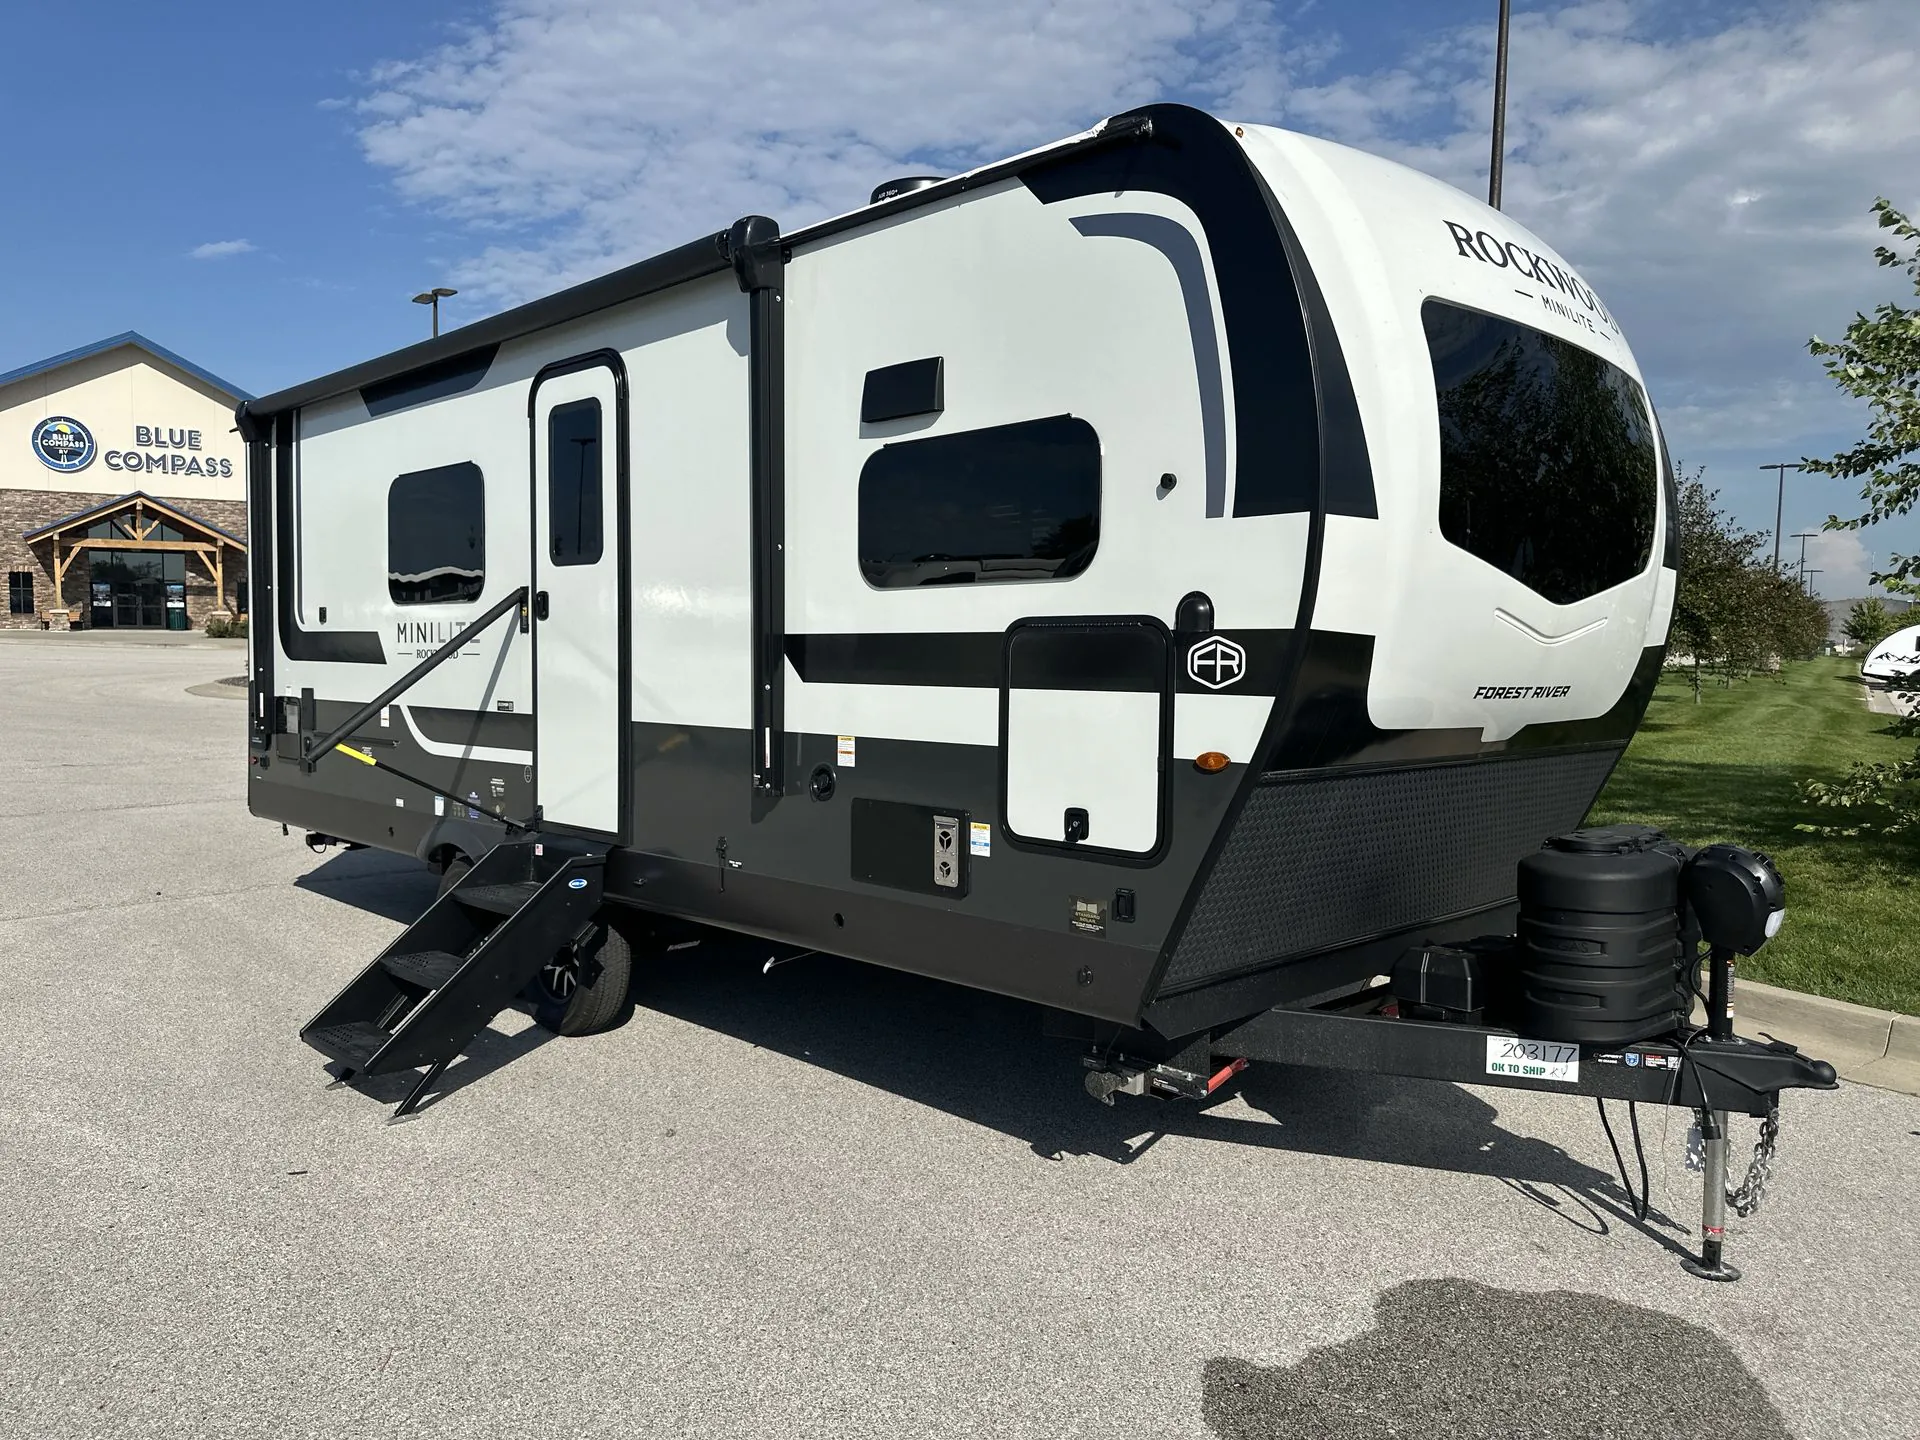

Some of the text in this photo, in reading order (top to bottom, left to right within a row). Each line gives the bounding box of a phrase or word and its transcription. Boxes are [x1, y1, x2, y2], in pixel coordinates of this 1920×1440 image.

[1541, 294, 1596, 334] MINILITE
[42, 439, 85, 448] COMPASS
[52, 433, 74, 441] BLUE
[136, 425, 202, 450] BLUE
[104, 450, 232, 477] COMPASS
[1473, 685, 1572, 699] FOREST RIVER
[1500, 1042, 1577, 1063] 203177
[1491, 1062, 1546, 1076] OK TO SHIP
